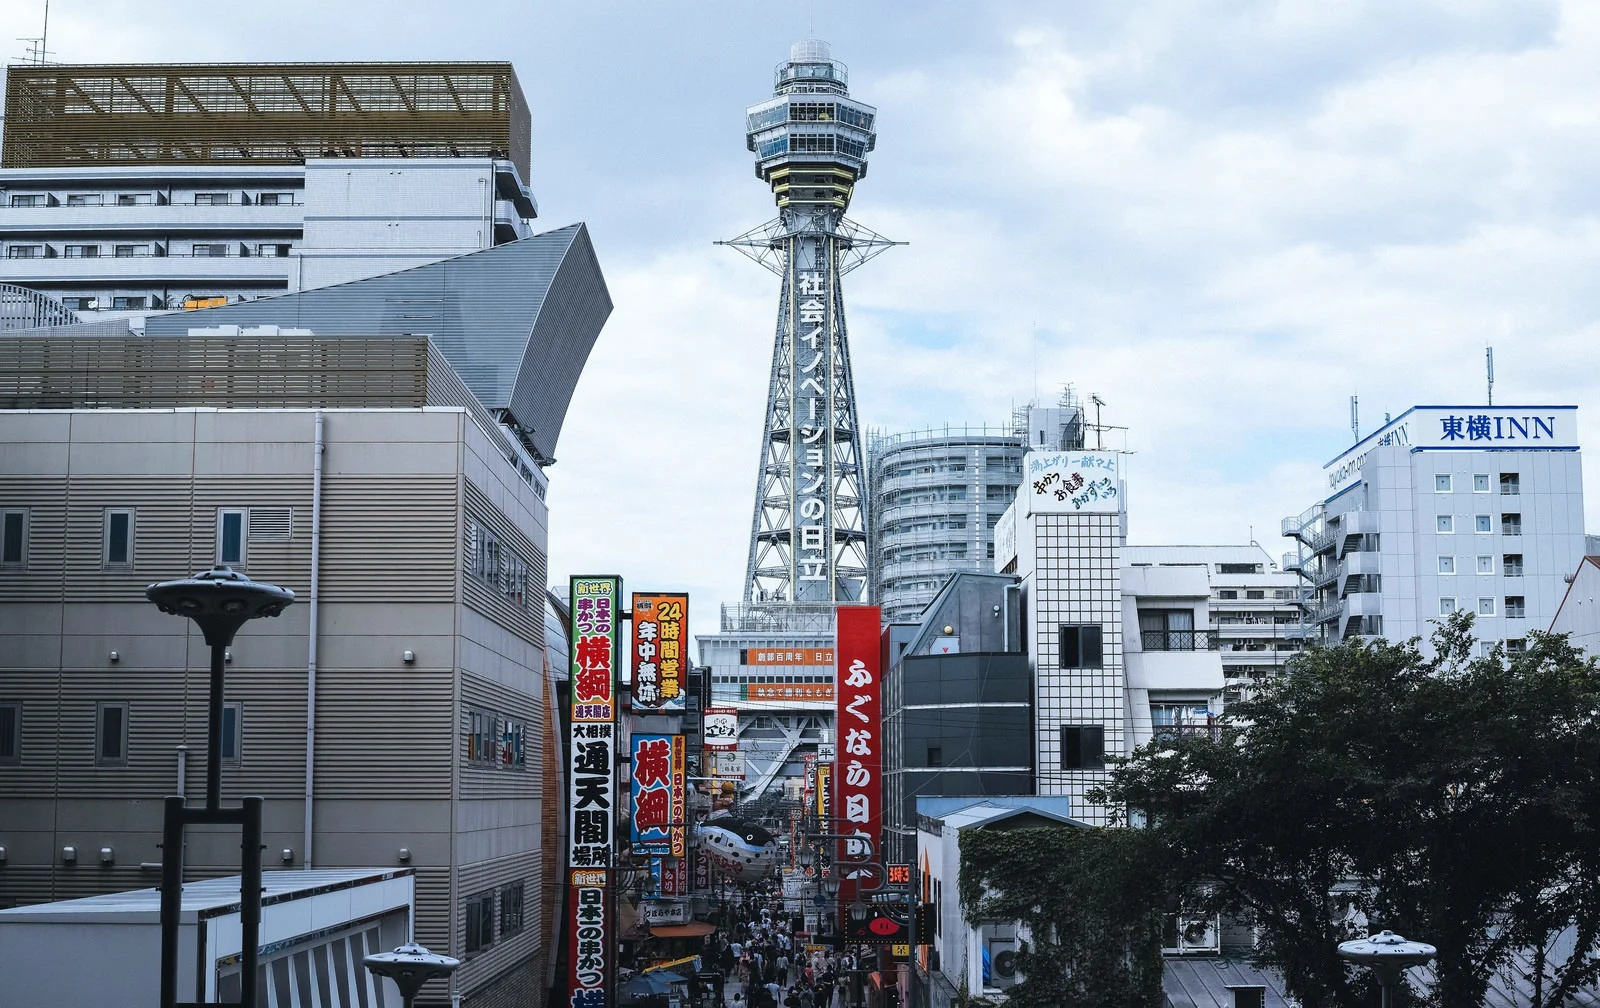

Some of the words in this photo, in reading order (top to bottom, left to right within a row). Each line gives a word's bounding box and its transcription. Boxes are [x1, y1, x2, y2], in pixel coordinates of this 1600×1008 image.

[799, 271, 826, 580] 社会イノベーションの日立
[1440, 415, 1555, 441] 東横INN
[1054, 472, 1084, 501] お食事
[577, 582, 612, 595] 新世界
[577, 598, 594, 635] 串かつ
[595, 598, 611, 634] 日本一の
[637, 621, 658, 702] 年中無休
[657, 602, 683, 698] 24時間営業
[757, 652, 803, 662] 創部百周年
[576, 635, 611, 702] 横綱
[575, 704, 611, 719] 通天閣店
[573, 724, 612, 739] 大相撲
[705, 724, 736, 737] エビス
[573, 740, 611, 845] 通天閣
[634, 739, 671, 835] 横綱
[673, 772, 684, 854] 日本一の串かつ
[572, 844, 611, 867] 場所
[576, 888, 604, 987] 日本一の串かつ
